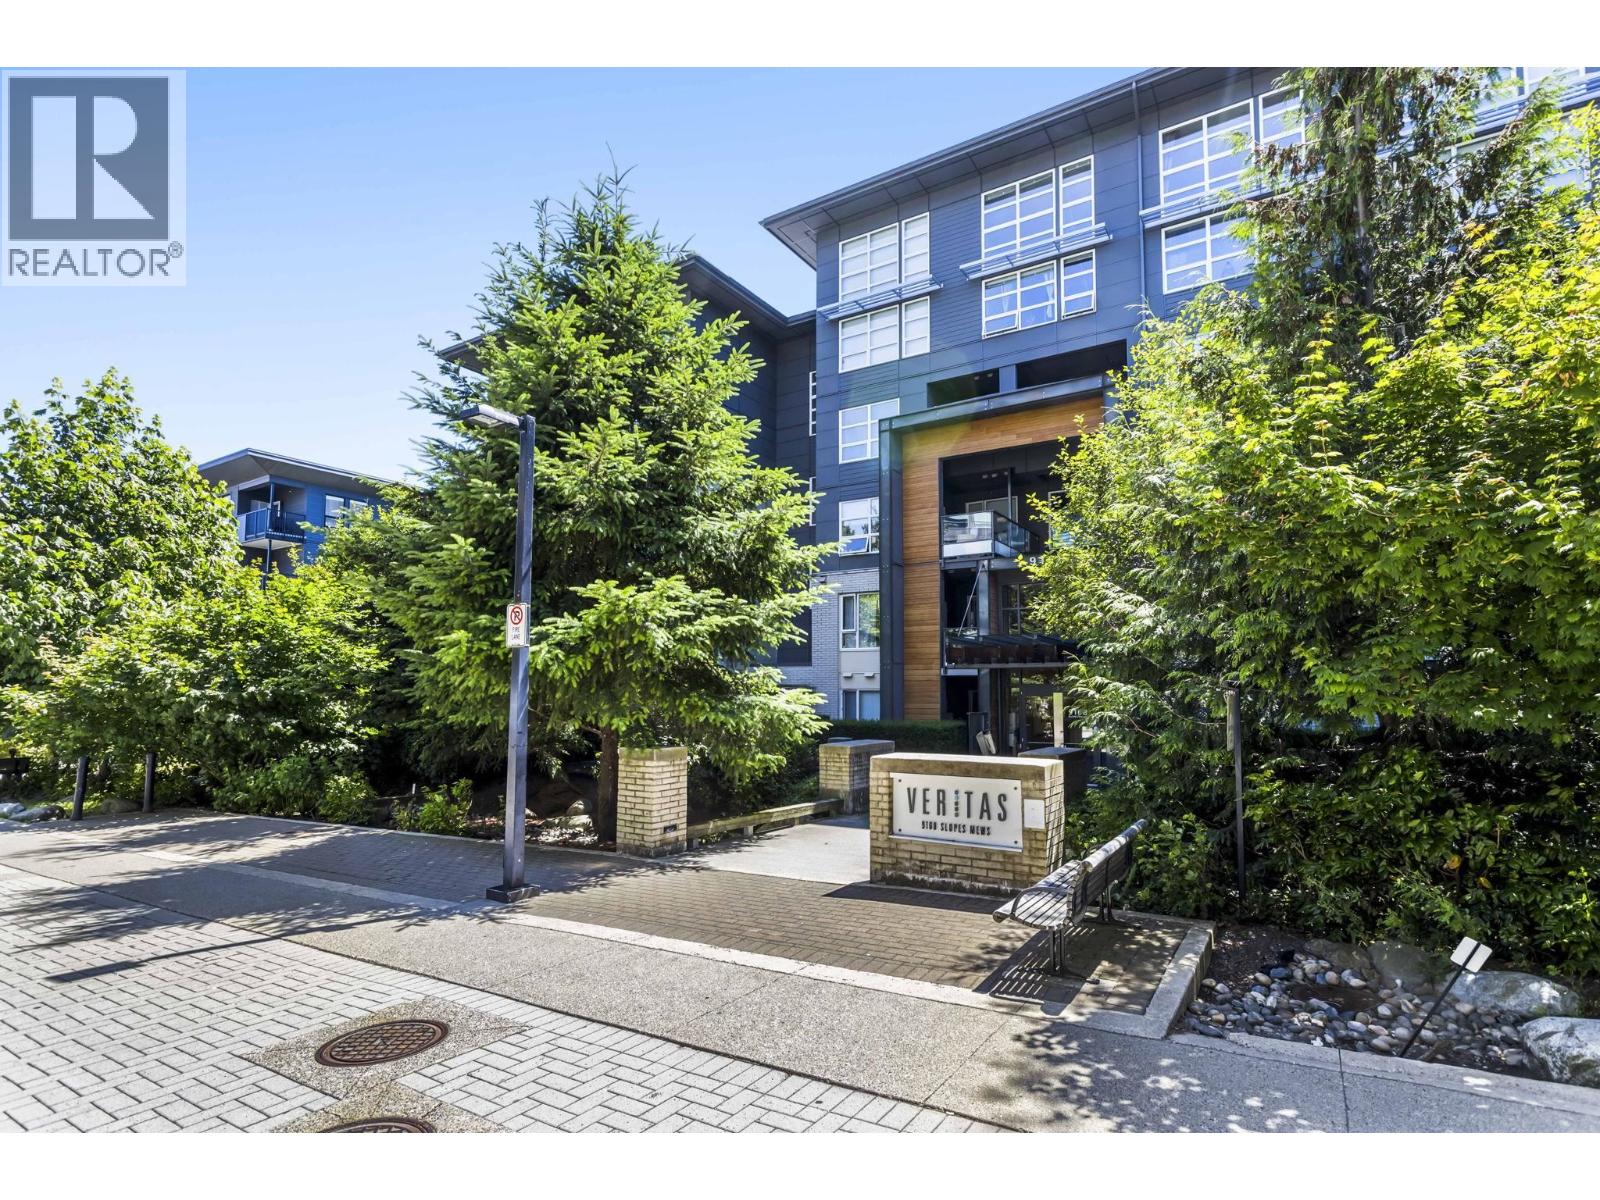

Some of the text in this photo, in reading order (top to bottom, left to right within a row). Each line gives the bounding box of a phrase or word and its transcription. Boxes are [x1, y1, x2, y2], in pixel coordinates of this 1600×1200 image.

[906, 786, 1008, 822] VERITAS
[940, 822, 966, 834] SLOPES
[969, 825, 991, 836] MEWS
